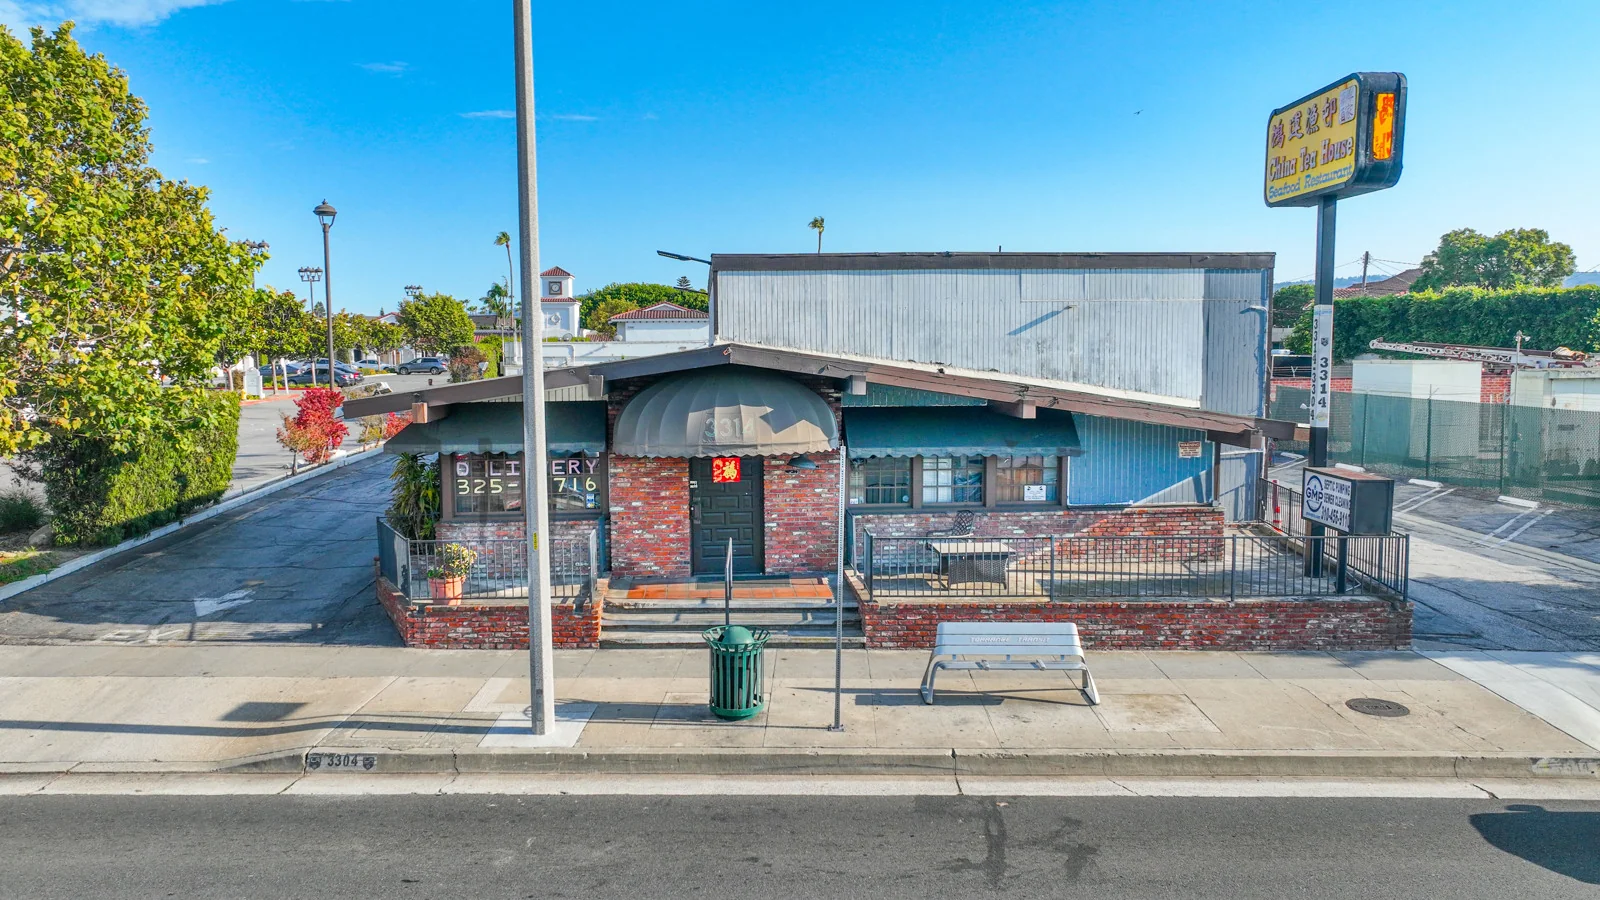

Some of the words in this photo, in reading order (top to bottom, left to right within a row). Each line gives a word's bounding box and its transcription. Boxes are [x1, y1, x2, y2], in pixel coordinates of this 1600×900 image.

[1269, 156, 1297, 181] China
[1300, 146, 1317, 172] Tea
[1320, 138, 1353, 165] House
[1269, 178, 1301, 198] Seafood
[1304, 165, 1352, 188] Restaurant
[1318, 356, 1328, 408] 3314
[704, 417, 754, 438] 3314
[1306, 487, 1323, 501] GMP
[1324, 479, 1335, 492] SEPTIC
[327, 754, 358, 767] 3304
